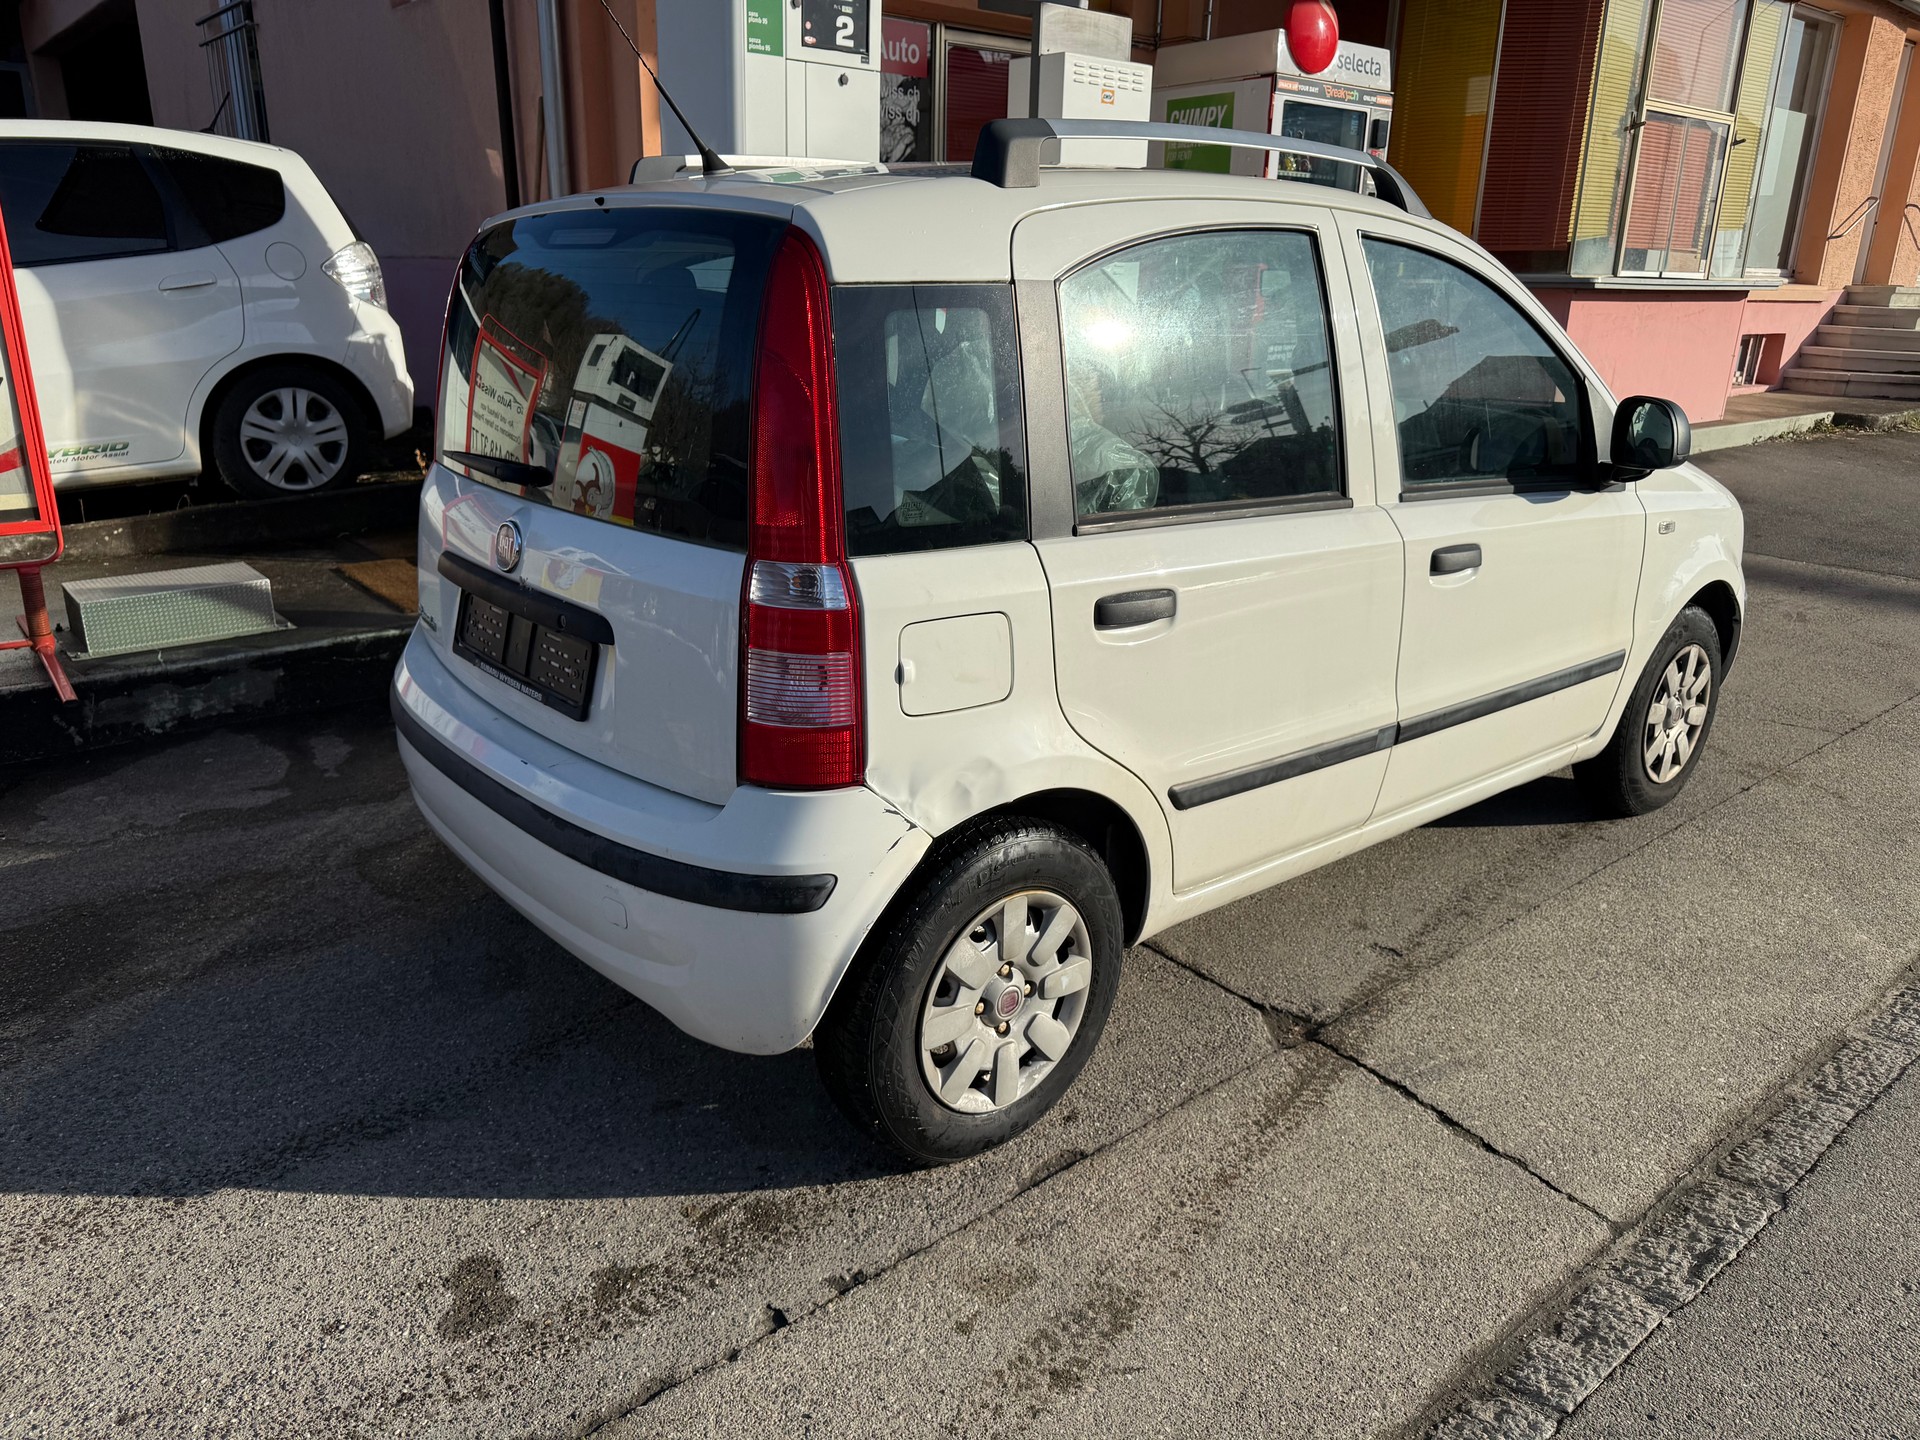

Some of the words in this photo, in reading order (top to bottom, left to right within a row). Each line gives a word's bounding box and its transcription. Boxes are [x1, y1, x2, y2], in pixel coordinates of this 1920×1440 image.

[836, 15, 854, 48] 2
[1337, 53, 1381, 76] selecta
[1170, 104, 1228, 128] CHIMPY
[101, 451, 129, 459] Assist
[480, 662, 500, 678] SUBARU
[500, 672, 521, 690] WYSSEN
[520, 684, 543, 701] NATERS
